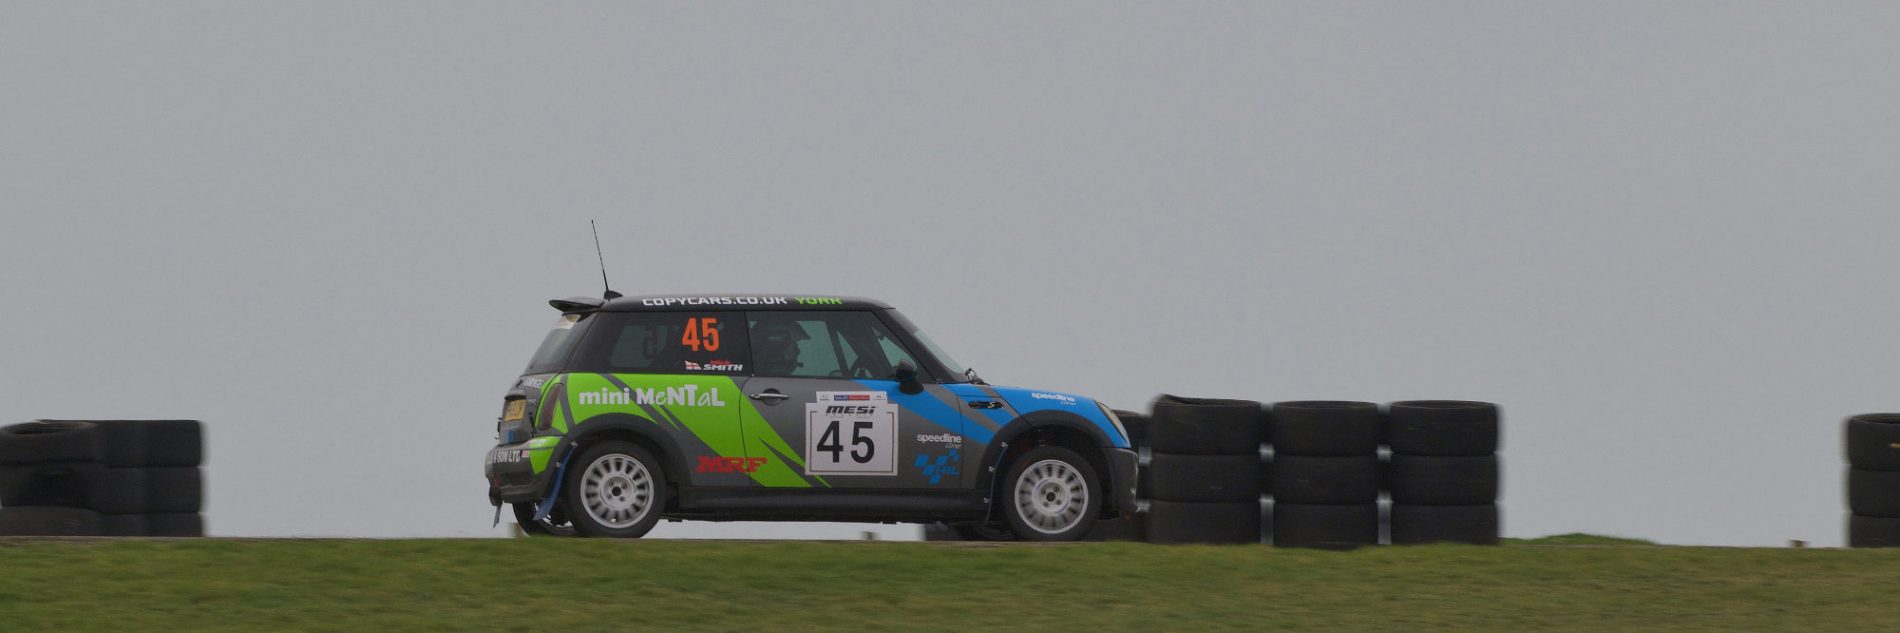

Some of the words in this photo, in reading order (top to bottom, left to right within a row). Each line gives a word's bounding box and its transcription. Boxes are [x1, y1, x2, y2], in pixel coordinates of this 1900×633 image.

[642, 296, 788, 306] COPYCARS.CO.UK
[794, 296, 843, 305] YORK
[682, 317, 720, 351] 45
[703, 363, 743, 372] SMITH
[579, 387, 630, 405] mini
[816, 420, 875, 464] 45
[916, 433, 962, 443] speedline
[695, 455, 768, 473] MRF
